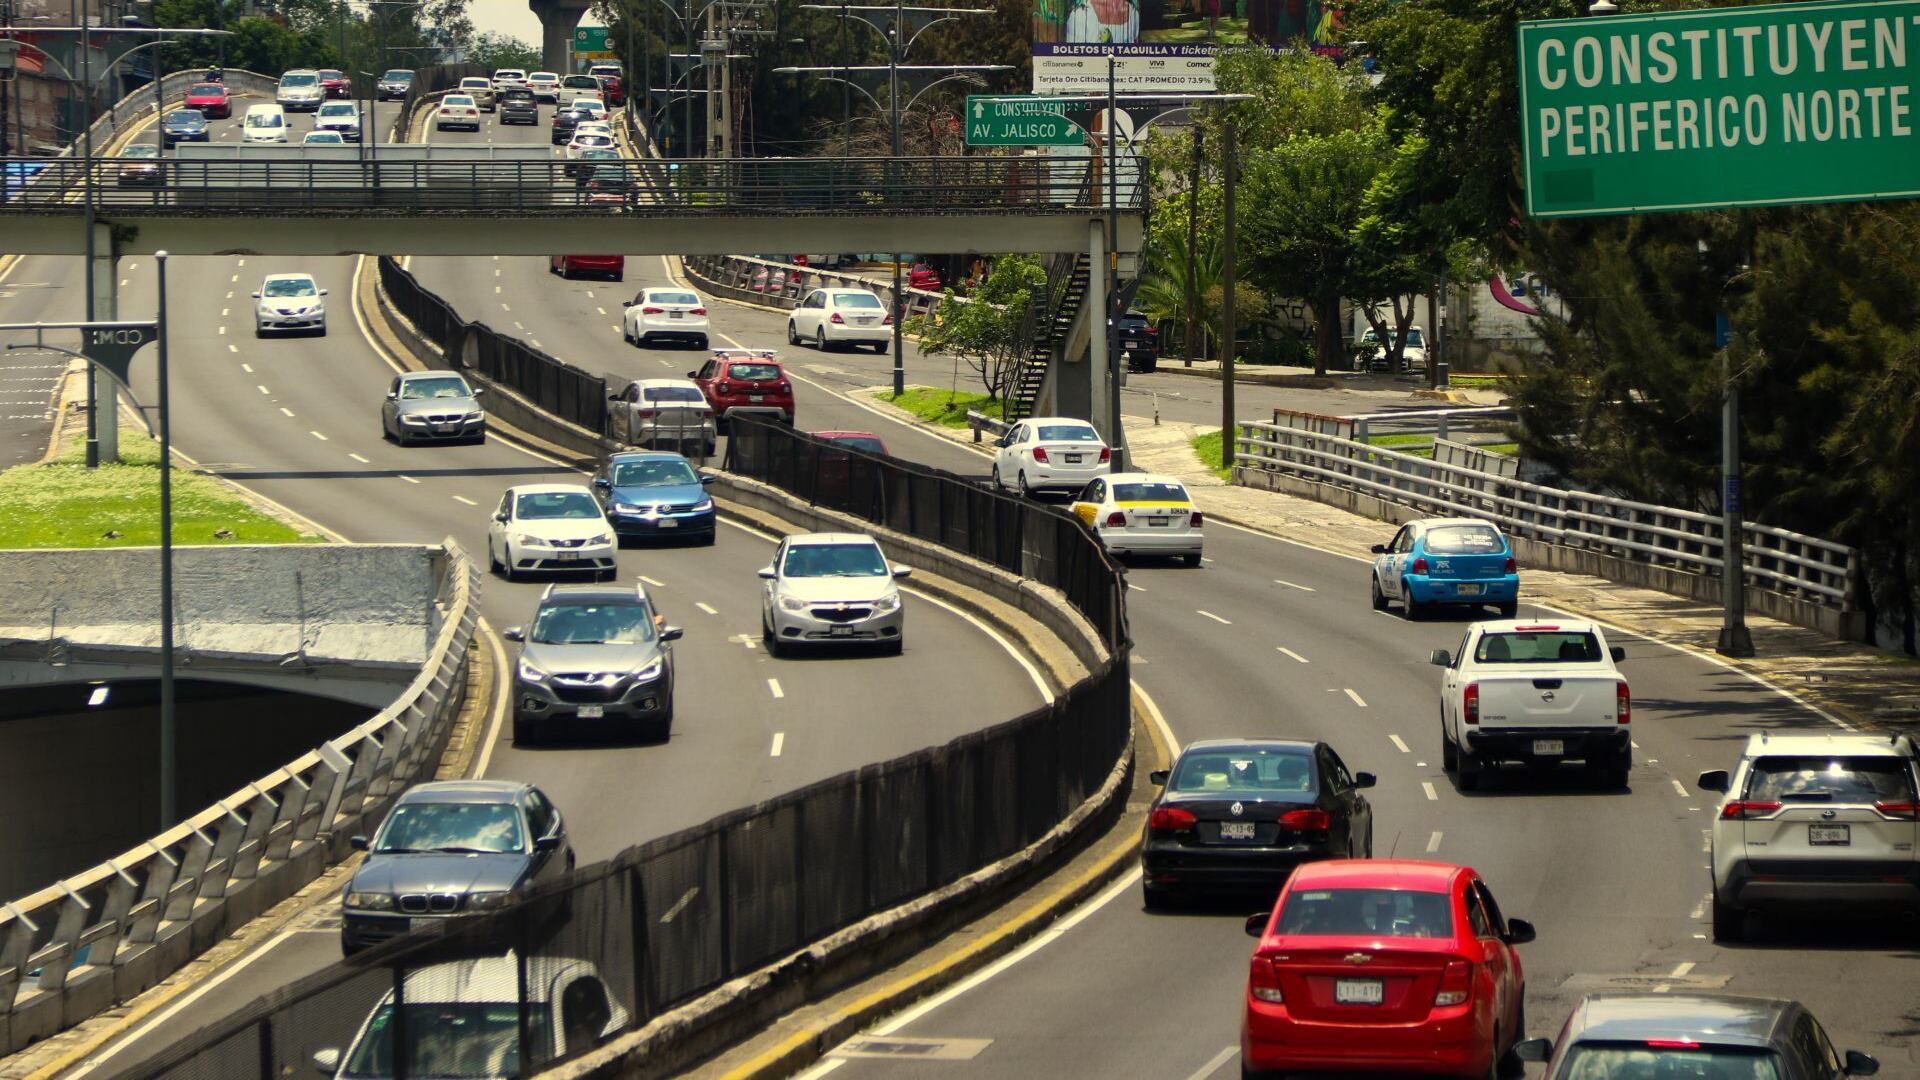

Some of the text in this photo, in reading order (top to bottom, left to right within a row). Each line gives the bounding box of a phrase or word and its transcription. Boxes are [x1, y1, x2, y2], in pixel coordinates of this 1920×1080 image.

[1053, 46, 1099, 54] BOLETOS
[1102, 46, 1114, 54] EN
[1117, 46, 1168, 54] TAQUILLA
[1171, 46, 1178, 54] Y
[1540, 86, 1911, 157] PERIFERICO NORTE
[973, 124, 1056, 138] AV. JALISCO
